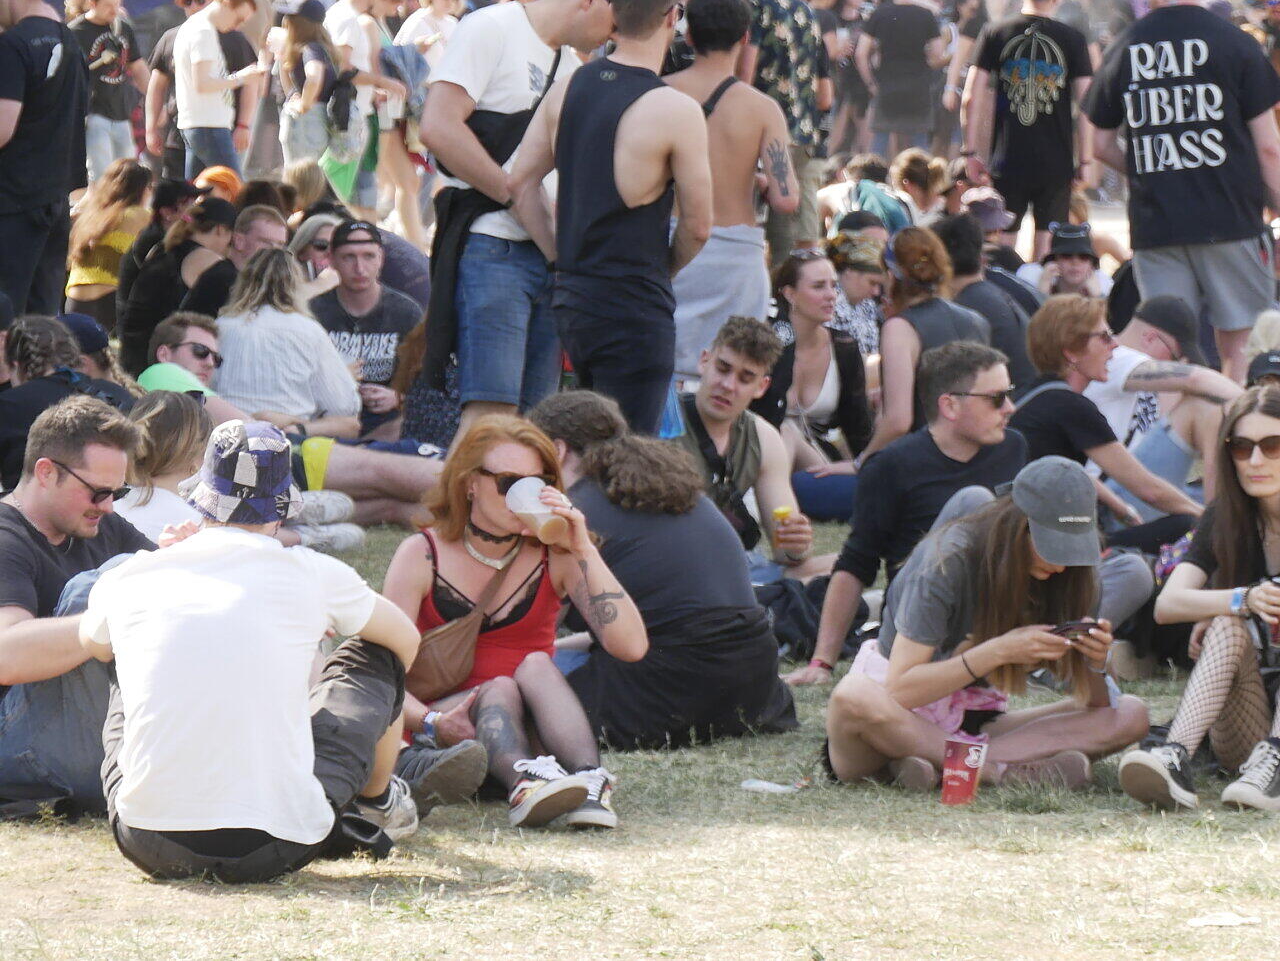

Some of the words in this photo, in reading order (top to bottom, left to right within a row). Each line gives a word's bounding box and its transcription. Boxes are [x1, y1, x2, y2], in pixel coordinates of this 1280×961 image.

[1129, 39, 1210, 82] RAP
[1123, 82, 1225, 129] ÜBER
[1132, 128, 1228, 175] HASS
